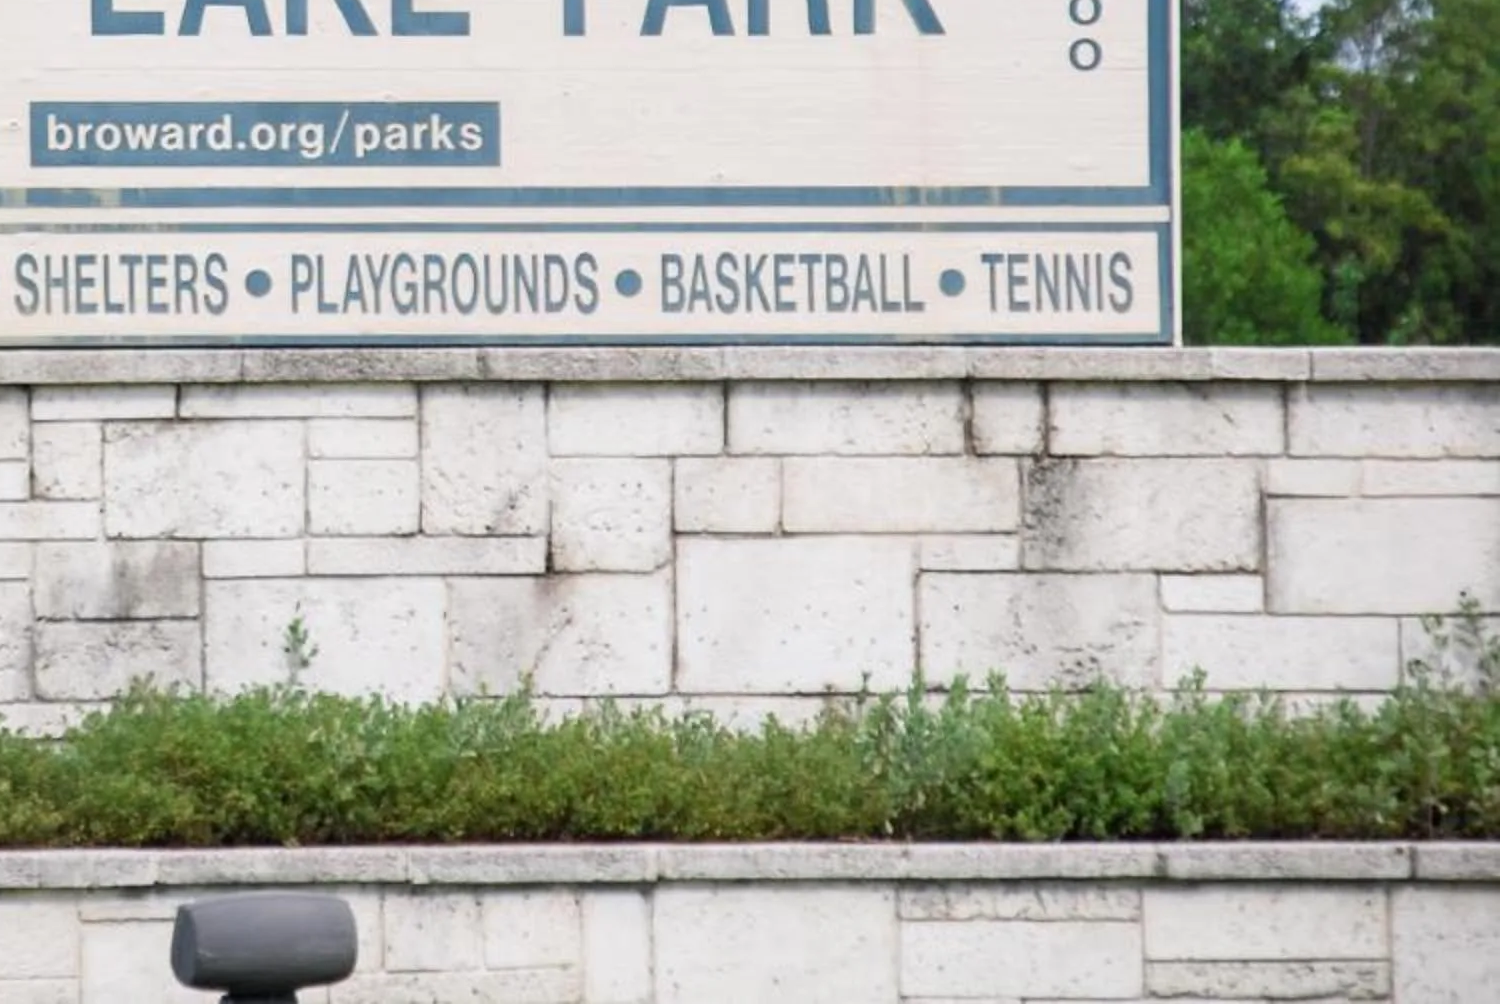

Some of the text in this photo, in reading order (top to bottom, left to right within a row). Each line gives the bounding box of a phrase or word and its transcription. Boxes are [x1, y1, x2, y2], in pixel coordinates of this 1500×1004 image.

[46, 110, 483, 158] broward.org/parks
[14, 252, 229, 316] SHELTERS
[291, 252, 599, 315] PLAYGROUNDS
[661, 252, 926, 314] BASKETBALL
[980, 251, 1133, 314] TENNIS
